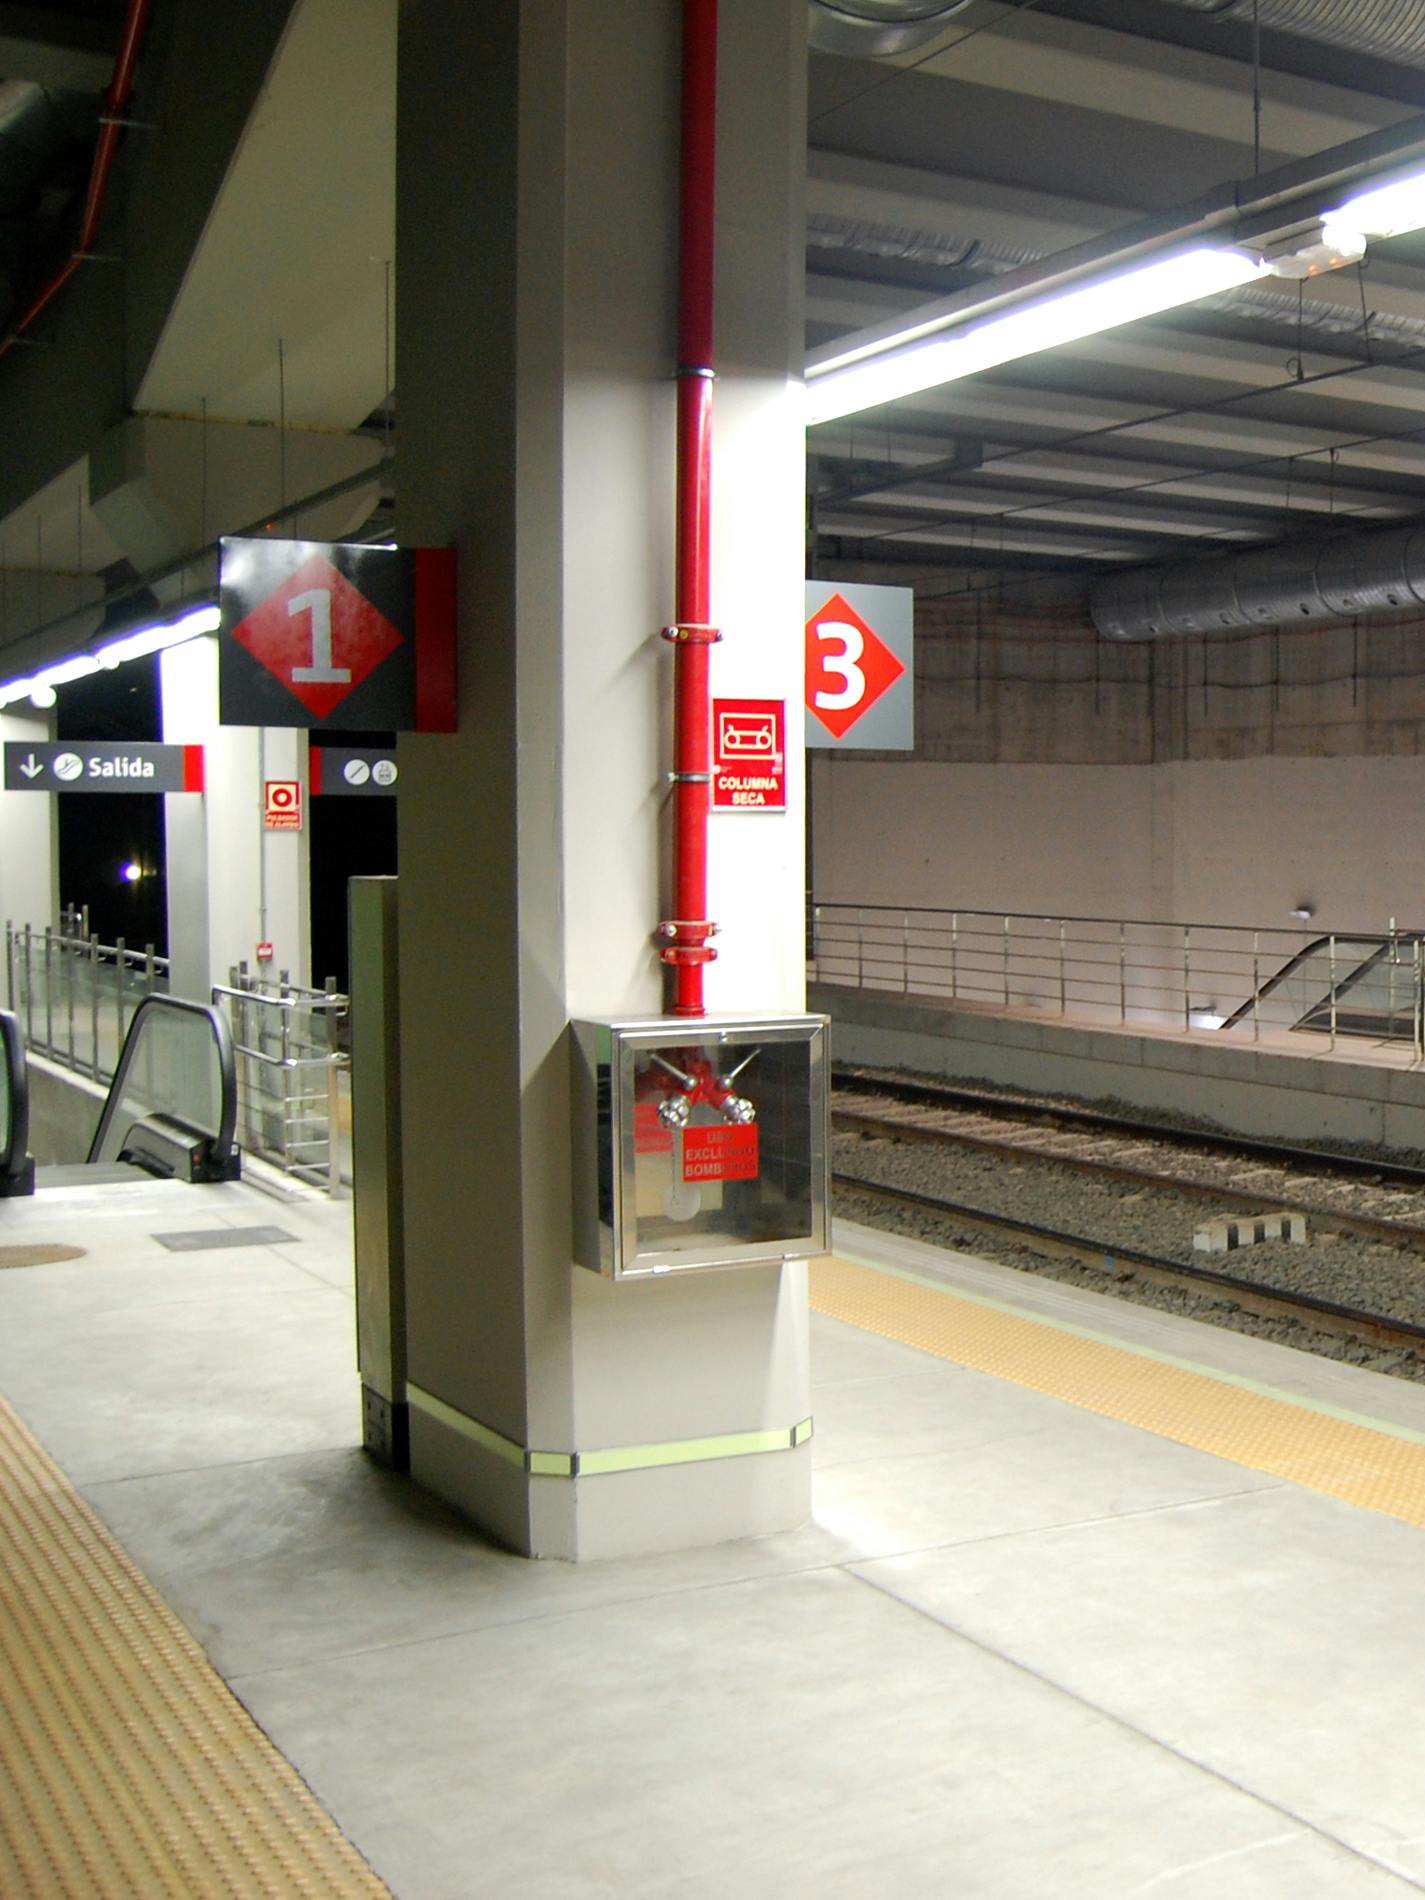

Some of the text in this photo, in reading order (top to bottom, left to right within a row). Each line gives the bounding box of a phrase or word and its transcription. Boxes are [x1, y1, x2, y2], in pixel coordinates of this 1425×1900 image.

[288, 588, 351, 684] 1
[815, 621, 866, 711] 3
[88, 757, 155, 778] Salida
[718, 776, 779, 791] COLUMNA
[732, 791, 766, 805] SECA
